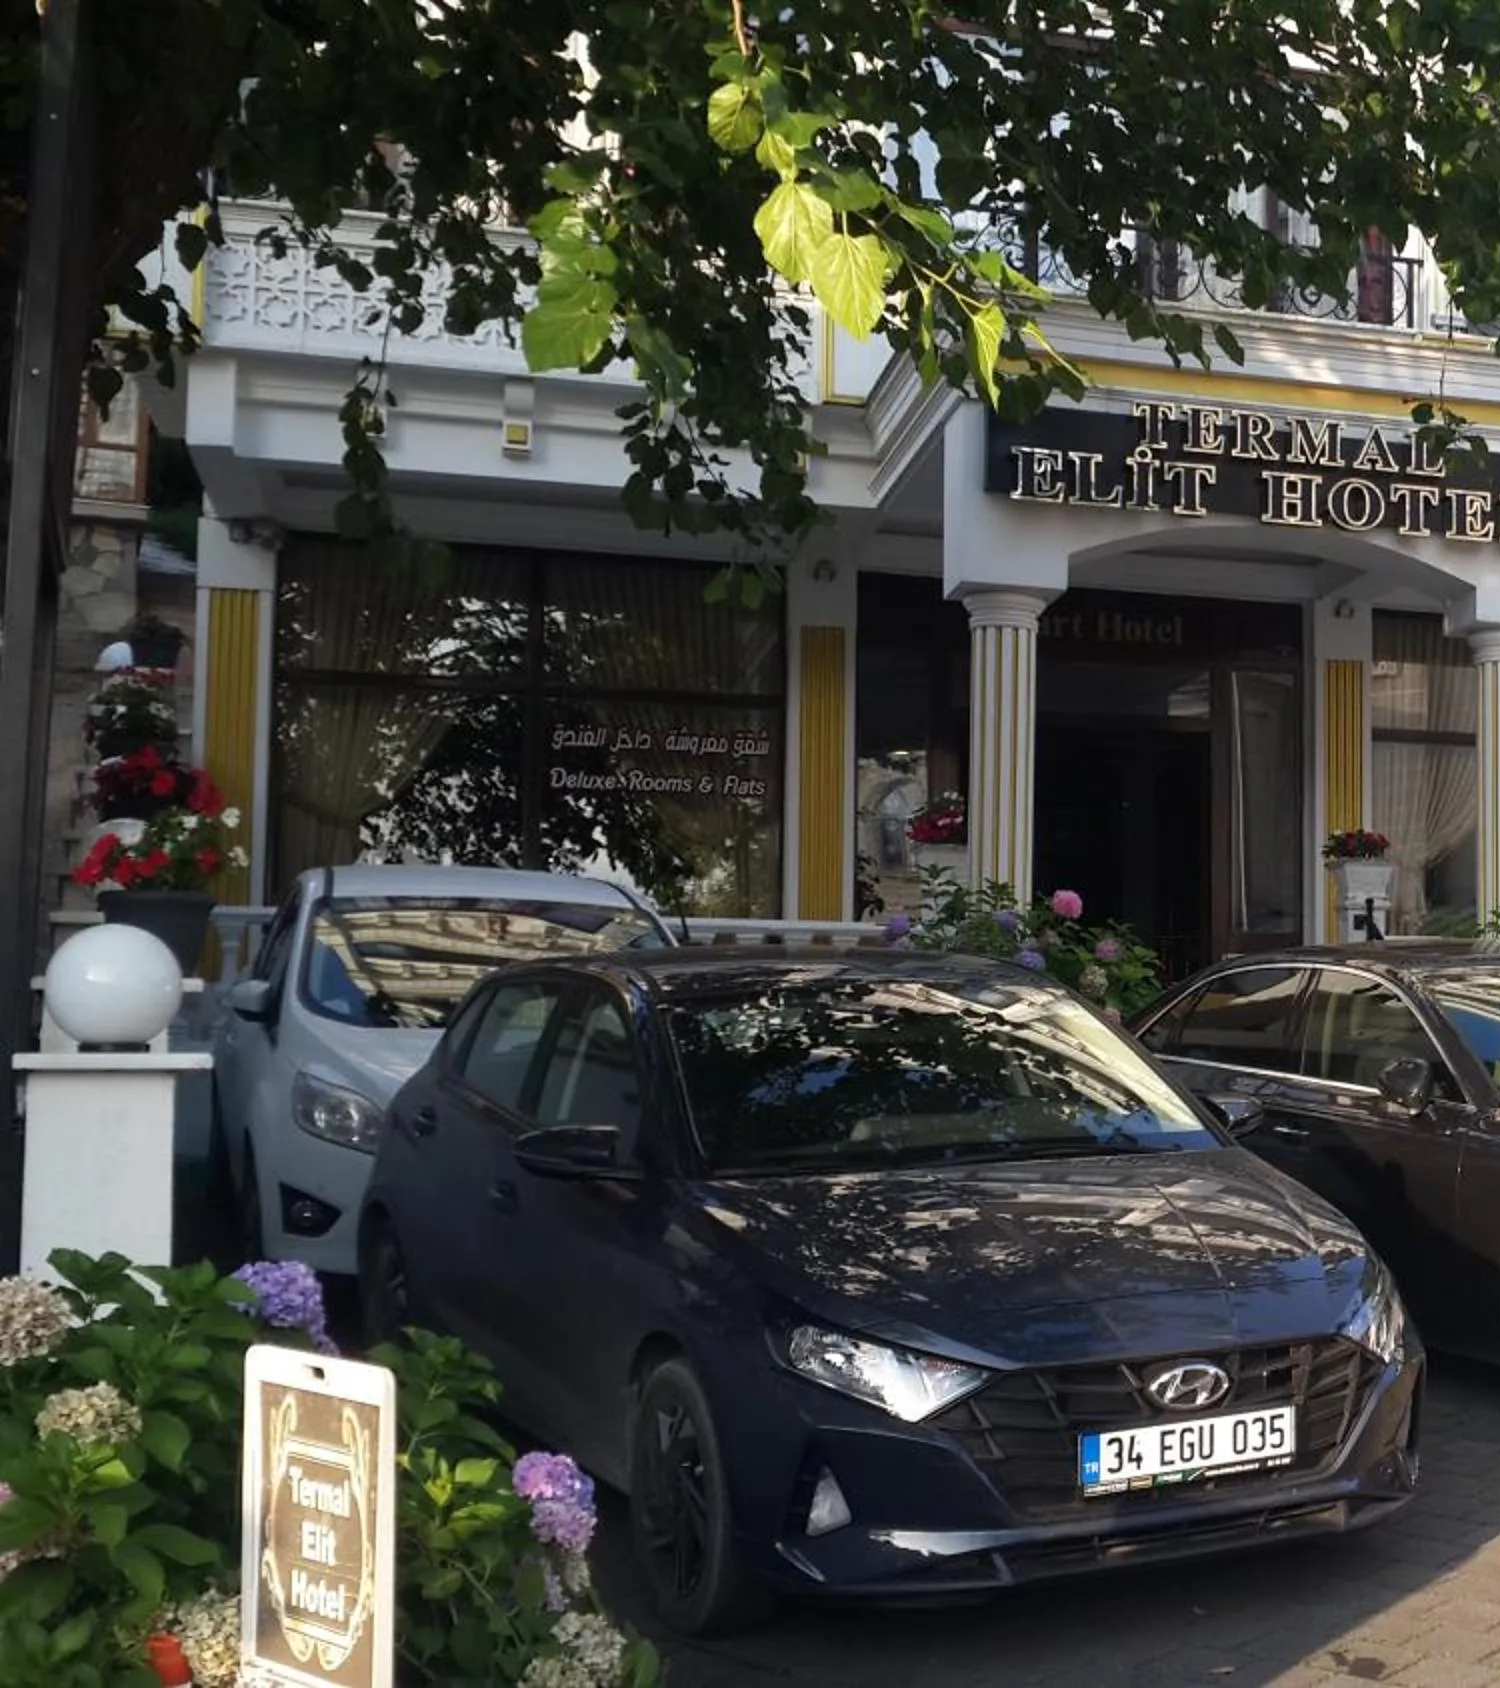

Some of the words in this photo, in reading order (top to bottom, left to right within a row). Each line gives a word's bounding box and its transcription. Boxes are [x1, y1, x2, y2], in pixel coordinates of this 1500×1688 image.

[1132, 400, 1446, 478] TERMAL
[1097, 610, 1183, 645] Hotel
[550, 767, 618, 790] Deluxe
[629, 769, 692, 793] Rooms
[699, 776, 713, 794] &
[723, 775, 766, 795] Flats
[1083, 1462, 1099, 1474] TR
[1107, 1435, 1143, 1474] 34
[1160, 1424, 1215, 1466] EGU
[289, 1466, 350, 1518] Termal
[301, 1521, 336, 1567] Elit
[291, 1570, 345, 1621] Hotel
